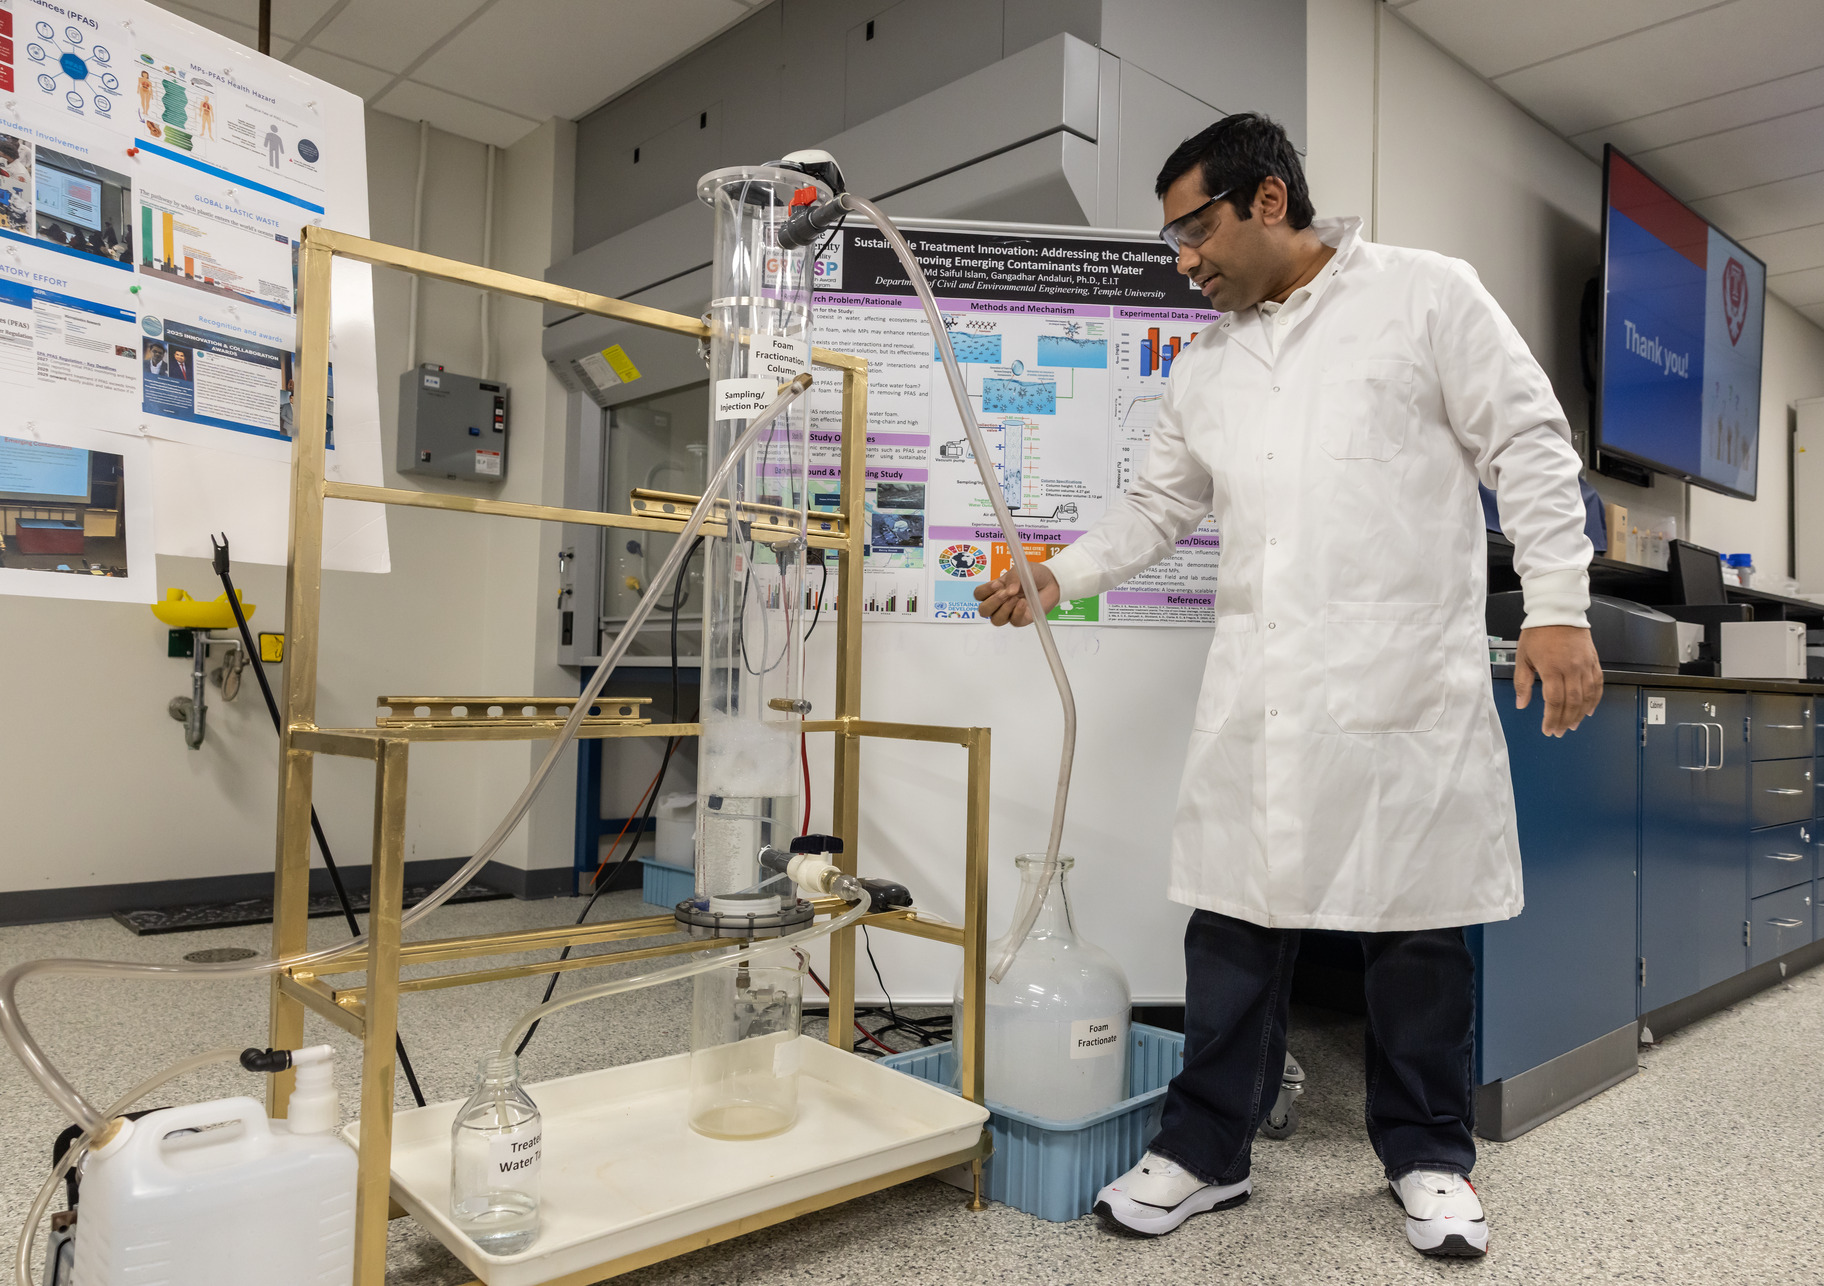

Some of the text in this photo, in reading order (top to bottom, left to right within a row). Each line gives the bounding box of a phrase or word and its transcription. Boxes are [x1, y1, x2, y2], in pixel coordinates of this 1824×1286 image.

[67, 10, 98, 30] (PFAS)
[190, 63, 225, 83] MPs-PFAS
[227, 79, 250, 93] Health
[252, 89, 276, 104] Hazard
[36, 130, 89, 154] Involvement
[150, 192, 173, 205] pathway
[181, 204, 196, 214] which
[197, 207, 214, 219] plastic
[194, 195, 223, 209] GLOBAL
[225, 204, 253, 219] PLASTIC
[255, 215, 280, 227] WASTE
[854, 237, 1172, 264] Sustainle Treatment Innovation: Addressing the Challenge
[955, 257, 1004, 271] Emerging
[1007, 259, 1081, 272] Contaminants
[1083, 262, 1108, 273] from
[1111, 265, 1143, 275] Water
[33, 273, 67, 288] EFFORT
[923, 268, 938, 276] Md
[939, 269, 962, 278] Saiful
[964, 270, 989, 280] Islam,
[991, 272, 1036, 282] Gangadhar
[1038, 273, 1075, 284] Andaluri,
[1076, 276, 1101, 285] Ph.D.,
[875, 276, 914, 287] Departm
[937, 279, 956, 288] Civil
[976, 282, 1037, 293] Environmental
[1038, 284, 1090, 295] Engineering,
[1092, 287, 1122, 296] Temple
[1124, 288, 1166, 298] University
[828, 296, 902, 306] Problem/Rationale
[970, 302, 1075, 314] Methods and Mechanism
[1120, 309, 1169, 318] Experimental
[8, 320, 30, 330] (PFAS)
[198, 315, 283, 343] Recognition and awards
[5, 329, 33, 340] Regulation
[166, 329, 279, 361] 2025 INNOVATION COLLABORATION
[211, 346, 238, 356] AWARDS
[773, 340, 794, 351] Foam
[1624, 319, 1689, 379] Thank you!
[756, 351, 804, 366] Fractionation
[767, 364, 797, 376] Column
[725, 391, 765, 400] Sampling/
[720, 403, 751, 412] Injection
[810, 433, 832, 443] Study
[829, 467, 903, 479] & Study
[975, 530, 1061, 541] Sustainlity Impact
[995, 545, 1004, 554] 11
[1167, 596, 1212, 605] References
[1650, 700, 1663, 709] Cabinet
[1089, 1024, 1108, 1033] Foam
[1078, 1035, 1117, 1047] Fractionate
[500, 1156, 533, 1172] Water
